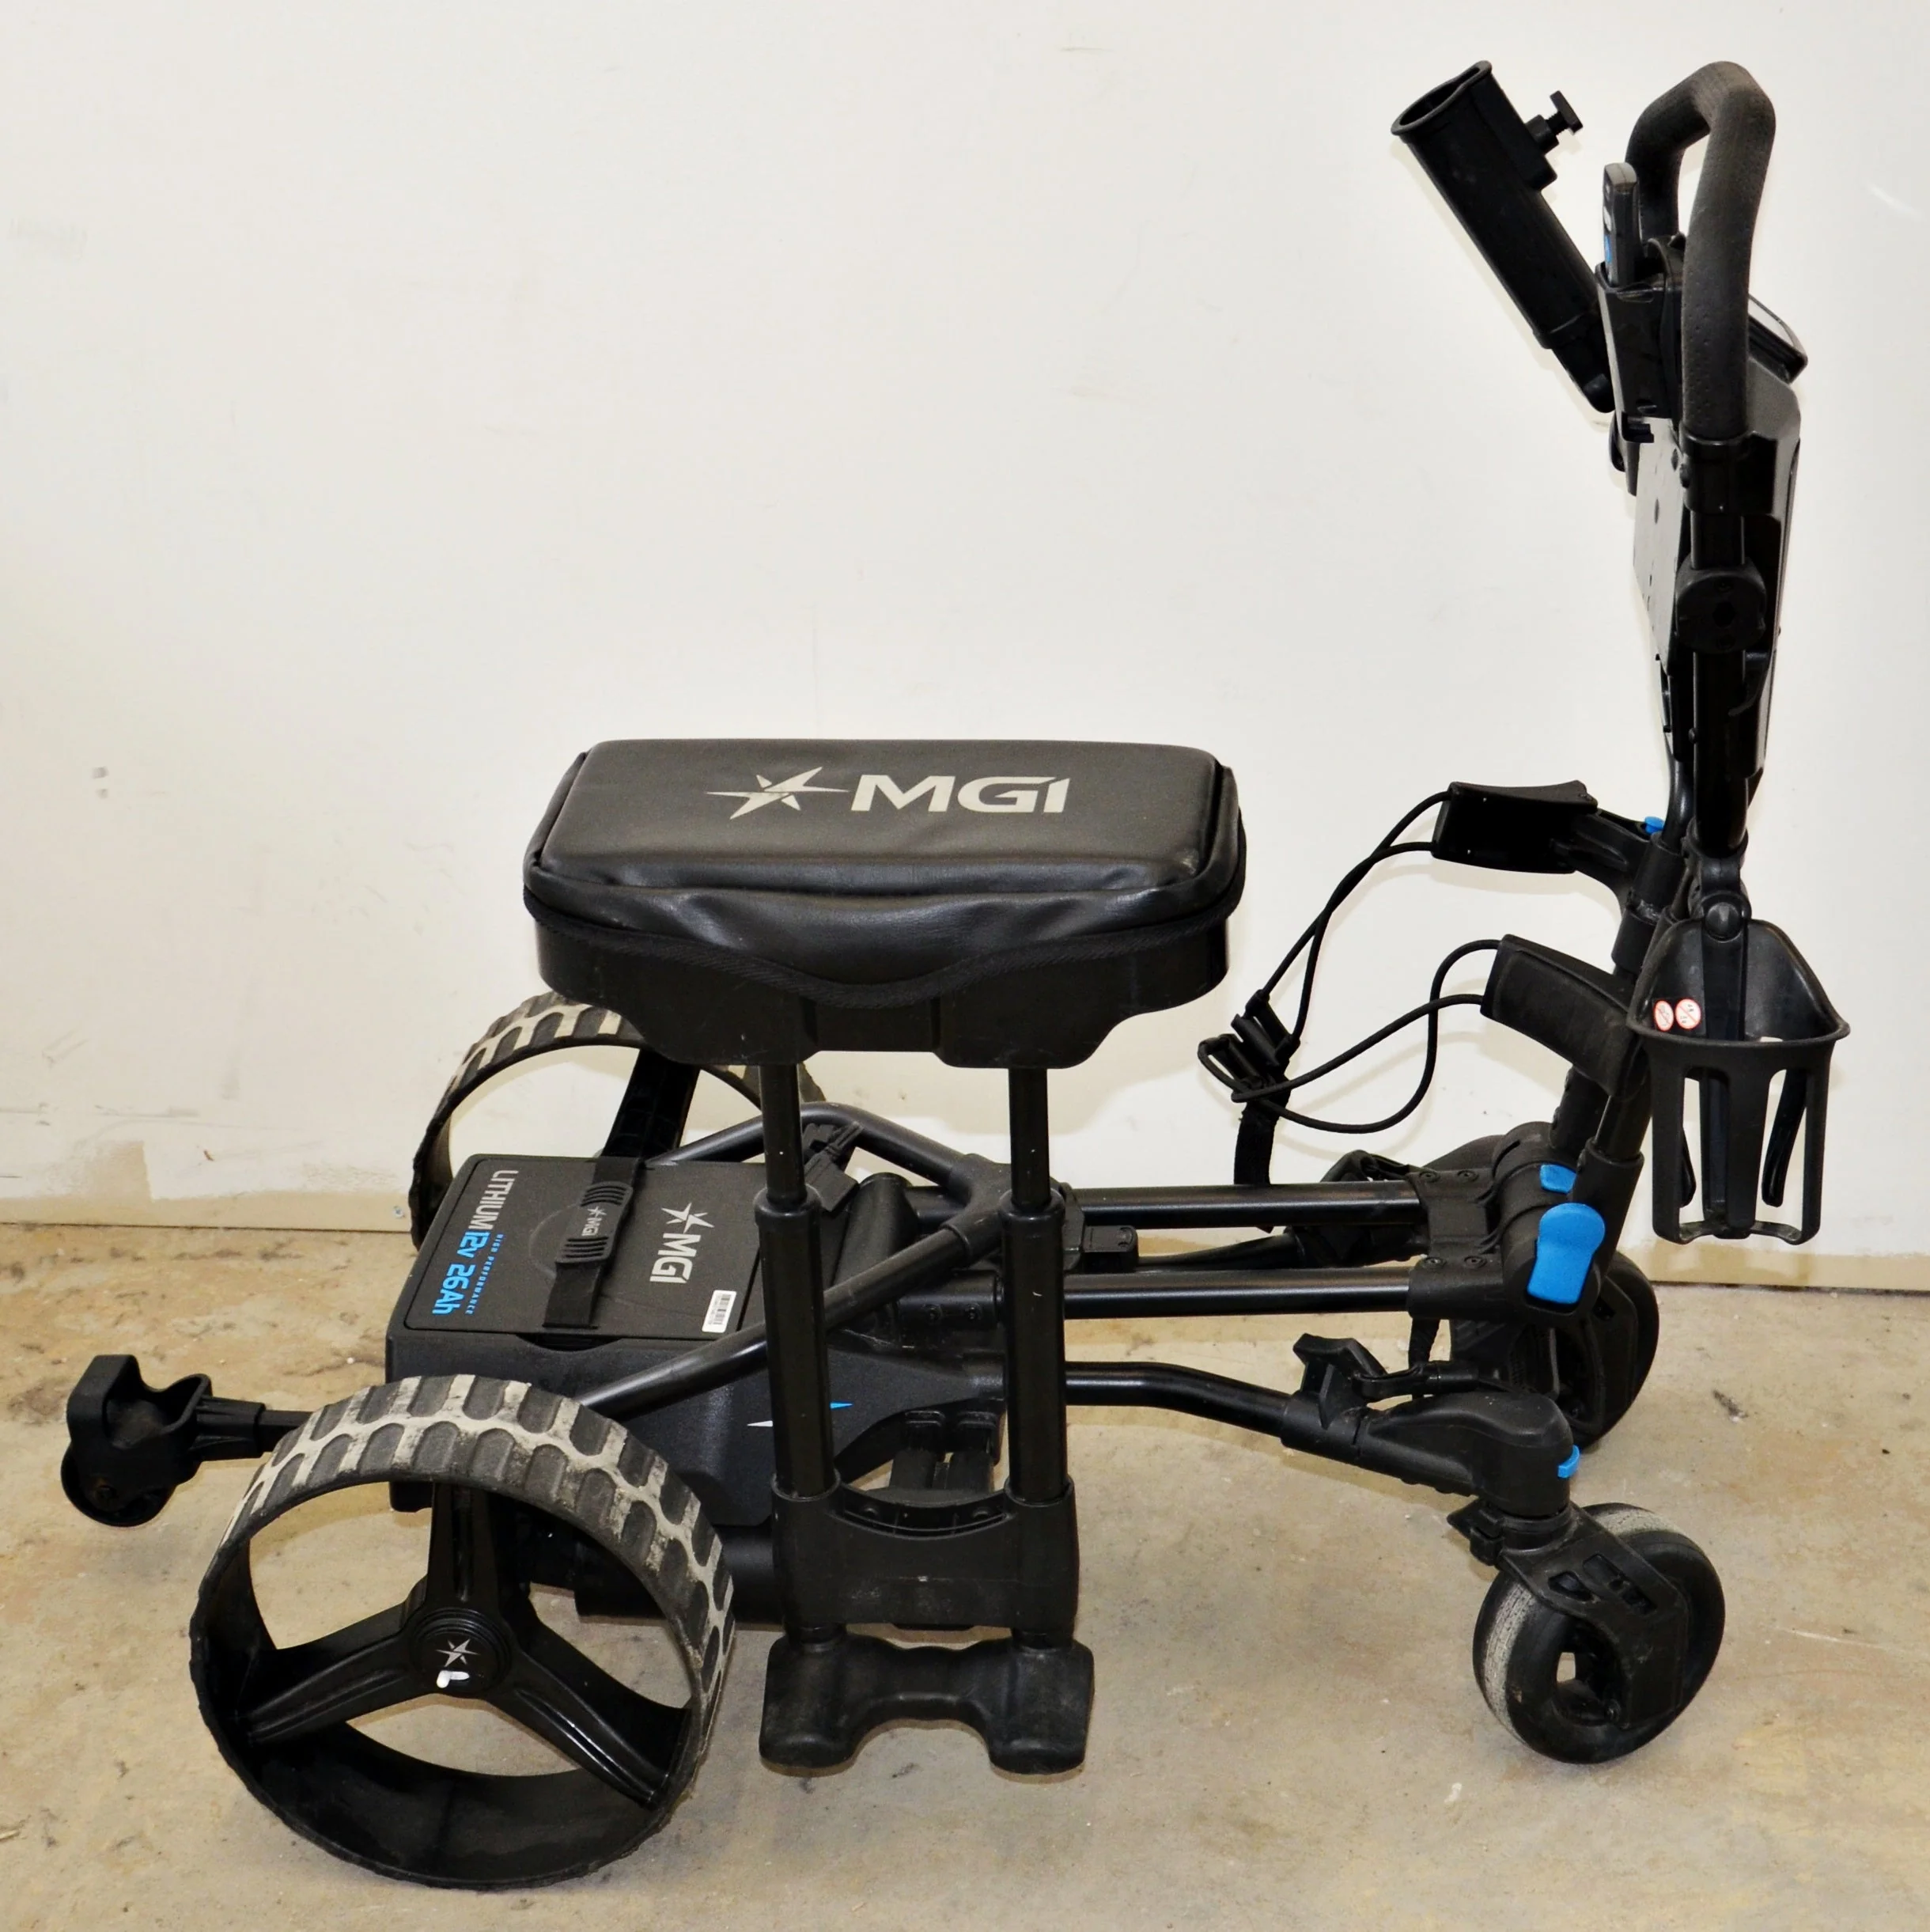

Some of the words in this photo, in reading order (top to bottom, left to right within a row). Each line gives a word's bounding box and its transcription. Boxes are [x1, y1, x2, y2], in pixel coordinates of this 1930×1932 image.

[850, 775, 1071, 814] MGI
[467, 1169, 520, 1231] LITHIUM
[649, 1233, 702, 1284] MGI
[432, 1263, 476, 1315] 26Ah
